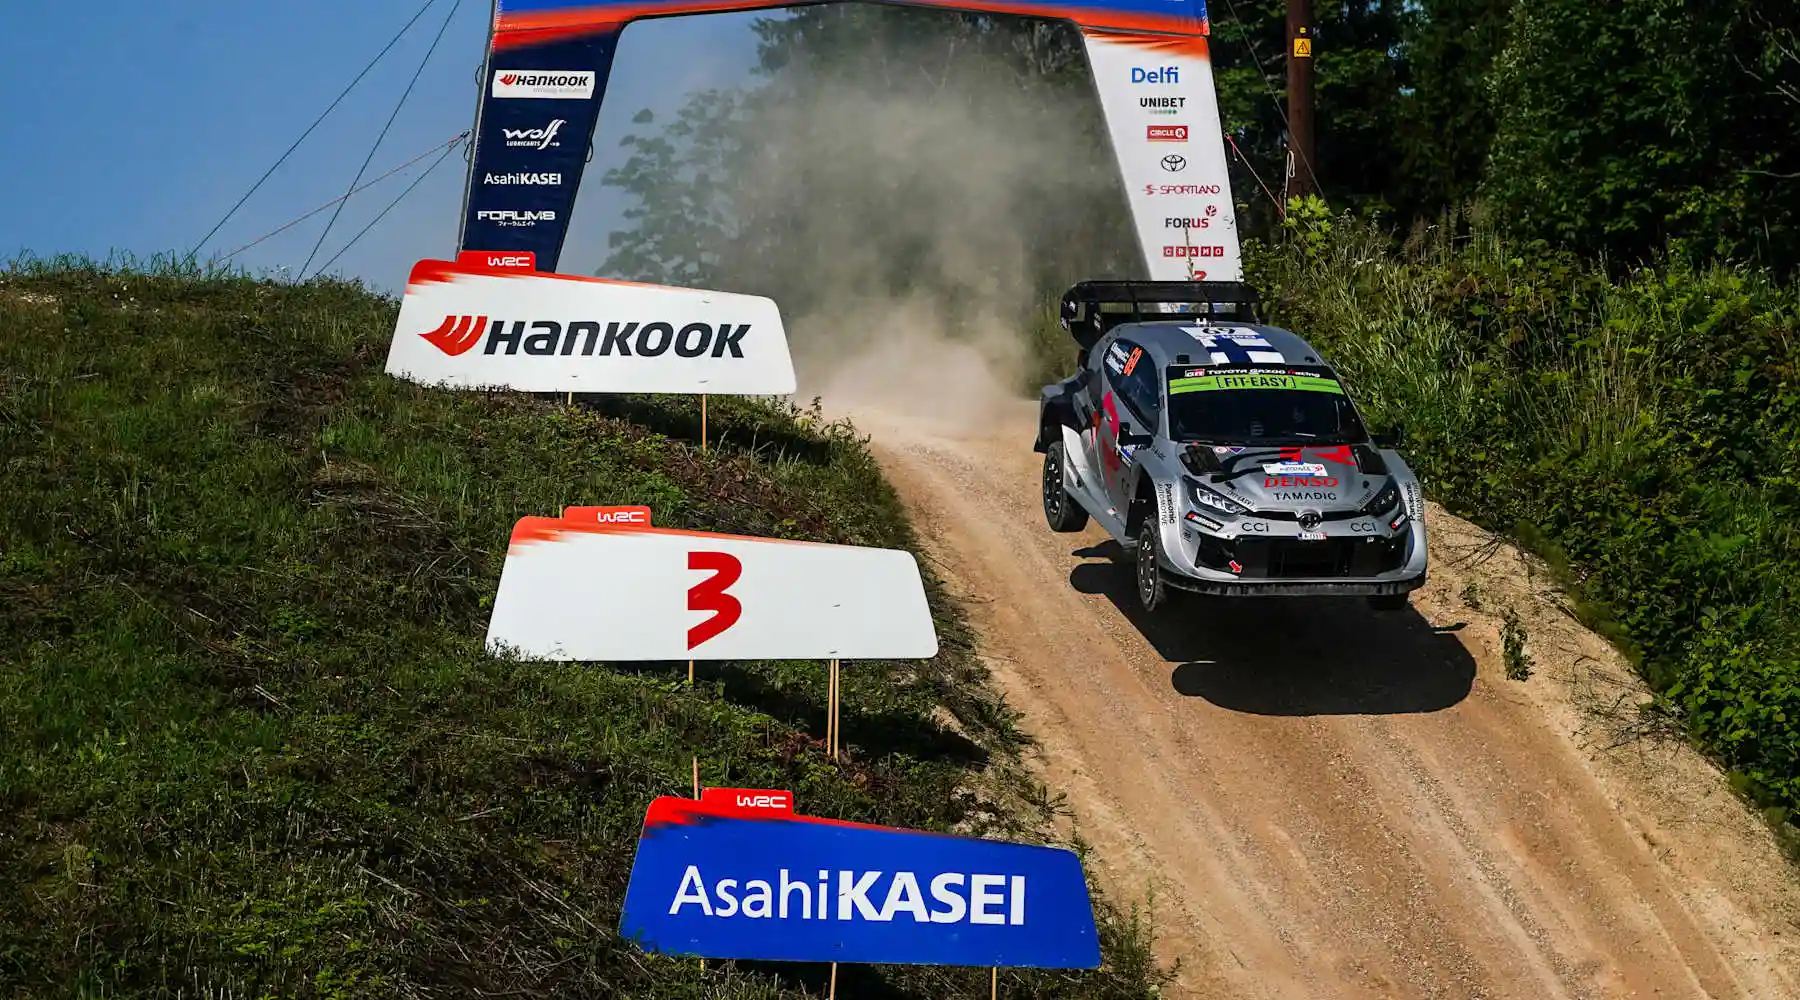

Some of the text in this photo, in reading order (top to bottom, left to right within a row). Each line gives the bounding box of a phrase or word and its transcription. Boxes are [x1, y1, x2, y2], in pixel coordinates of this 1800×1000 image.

[1131, 66, 1179, 83] Delfi
[1140, 97, 1186, 107] UNIBET
[484, 173, 562, 185] AsahiKASEI
[1160, 185, 1220, 194] SPORTLAND
[477, 210, 556, 220] FORUM8
[1165, 218, 1209, 228] FORUS
[487, 256, 530, 266] WRC
[1264, 476, 1339, 488] DENSO
[1273, 492, 1337, 501] TAMADIC
[1164, 483, 1176, 524] Panasonic
[597, 511, 645, 522] WRC
[687, 551, 743, 651] 3
[736, 794, 787, 808] WRC
[668, 865, 1026, 926] AsahiKASEI
